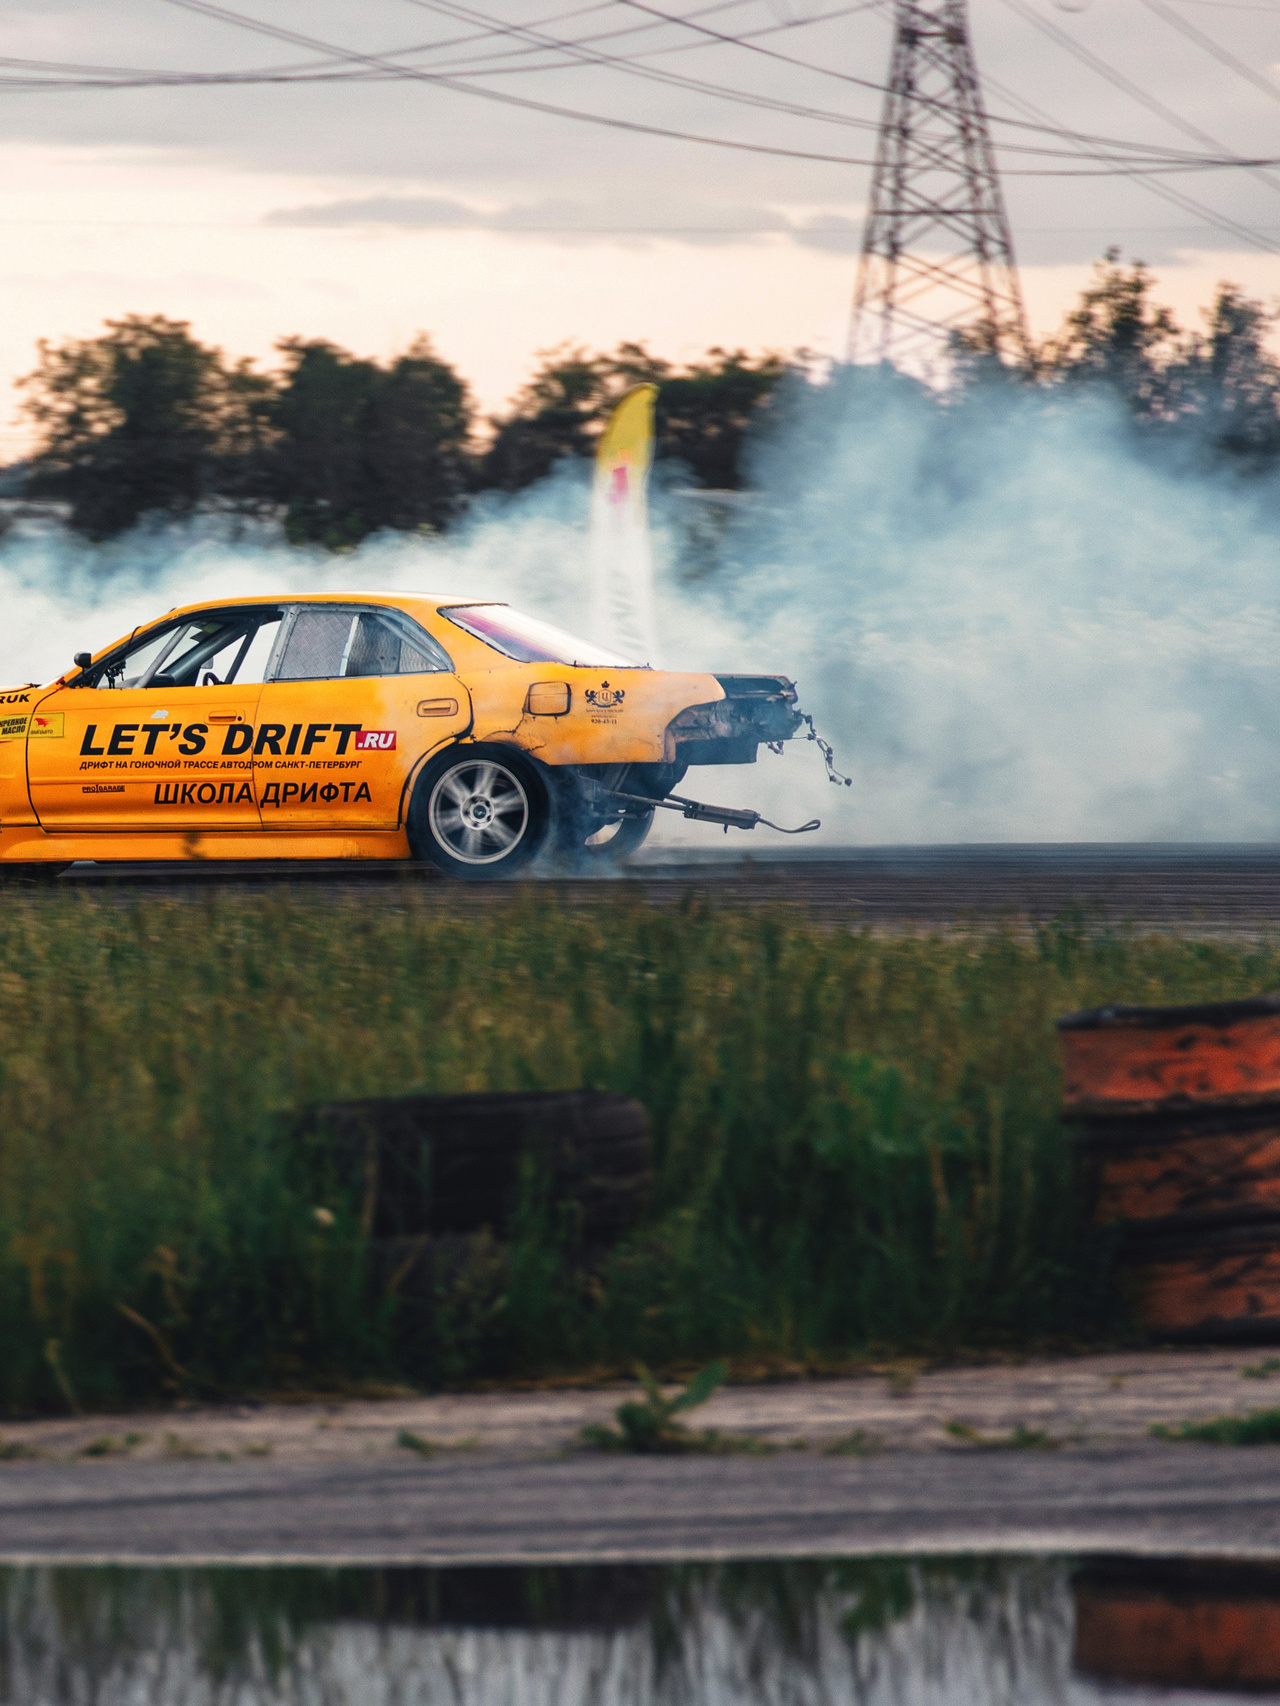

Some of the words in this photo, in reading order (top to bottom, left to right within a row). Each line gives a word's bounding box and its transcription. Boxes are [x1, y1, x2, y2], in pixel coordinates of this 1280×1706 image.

[1, 725, 26, 735] МАСЛО
[79, 723, 209, 756] LET'S
[222, 723, 363, 756] DRIFT
[358, 731, 395, 749] .RU
[79, 760, 114, 770] ДРИФТ
[115, 761, 128, 769] НА
[129, 759, 181, 769] ГОНОЧНОЙ
[183, 760, 219, 769] ТРАССЕ
[220, 760, 273, 770] АВТОДРОМ
[274, 760, 362, 769] САНКТ-ПЕТЕРБУРГ
[154, 782, 254, 805] ШКОЛА
[259, 782, 372, 808] ДРИФТА
